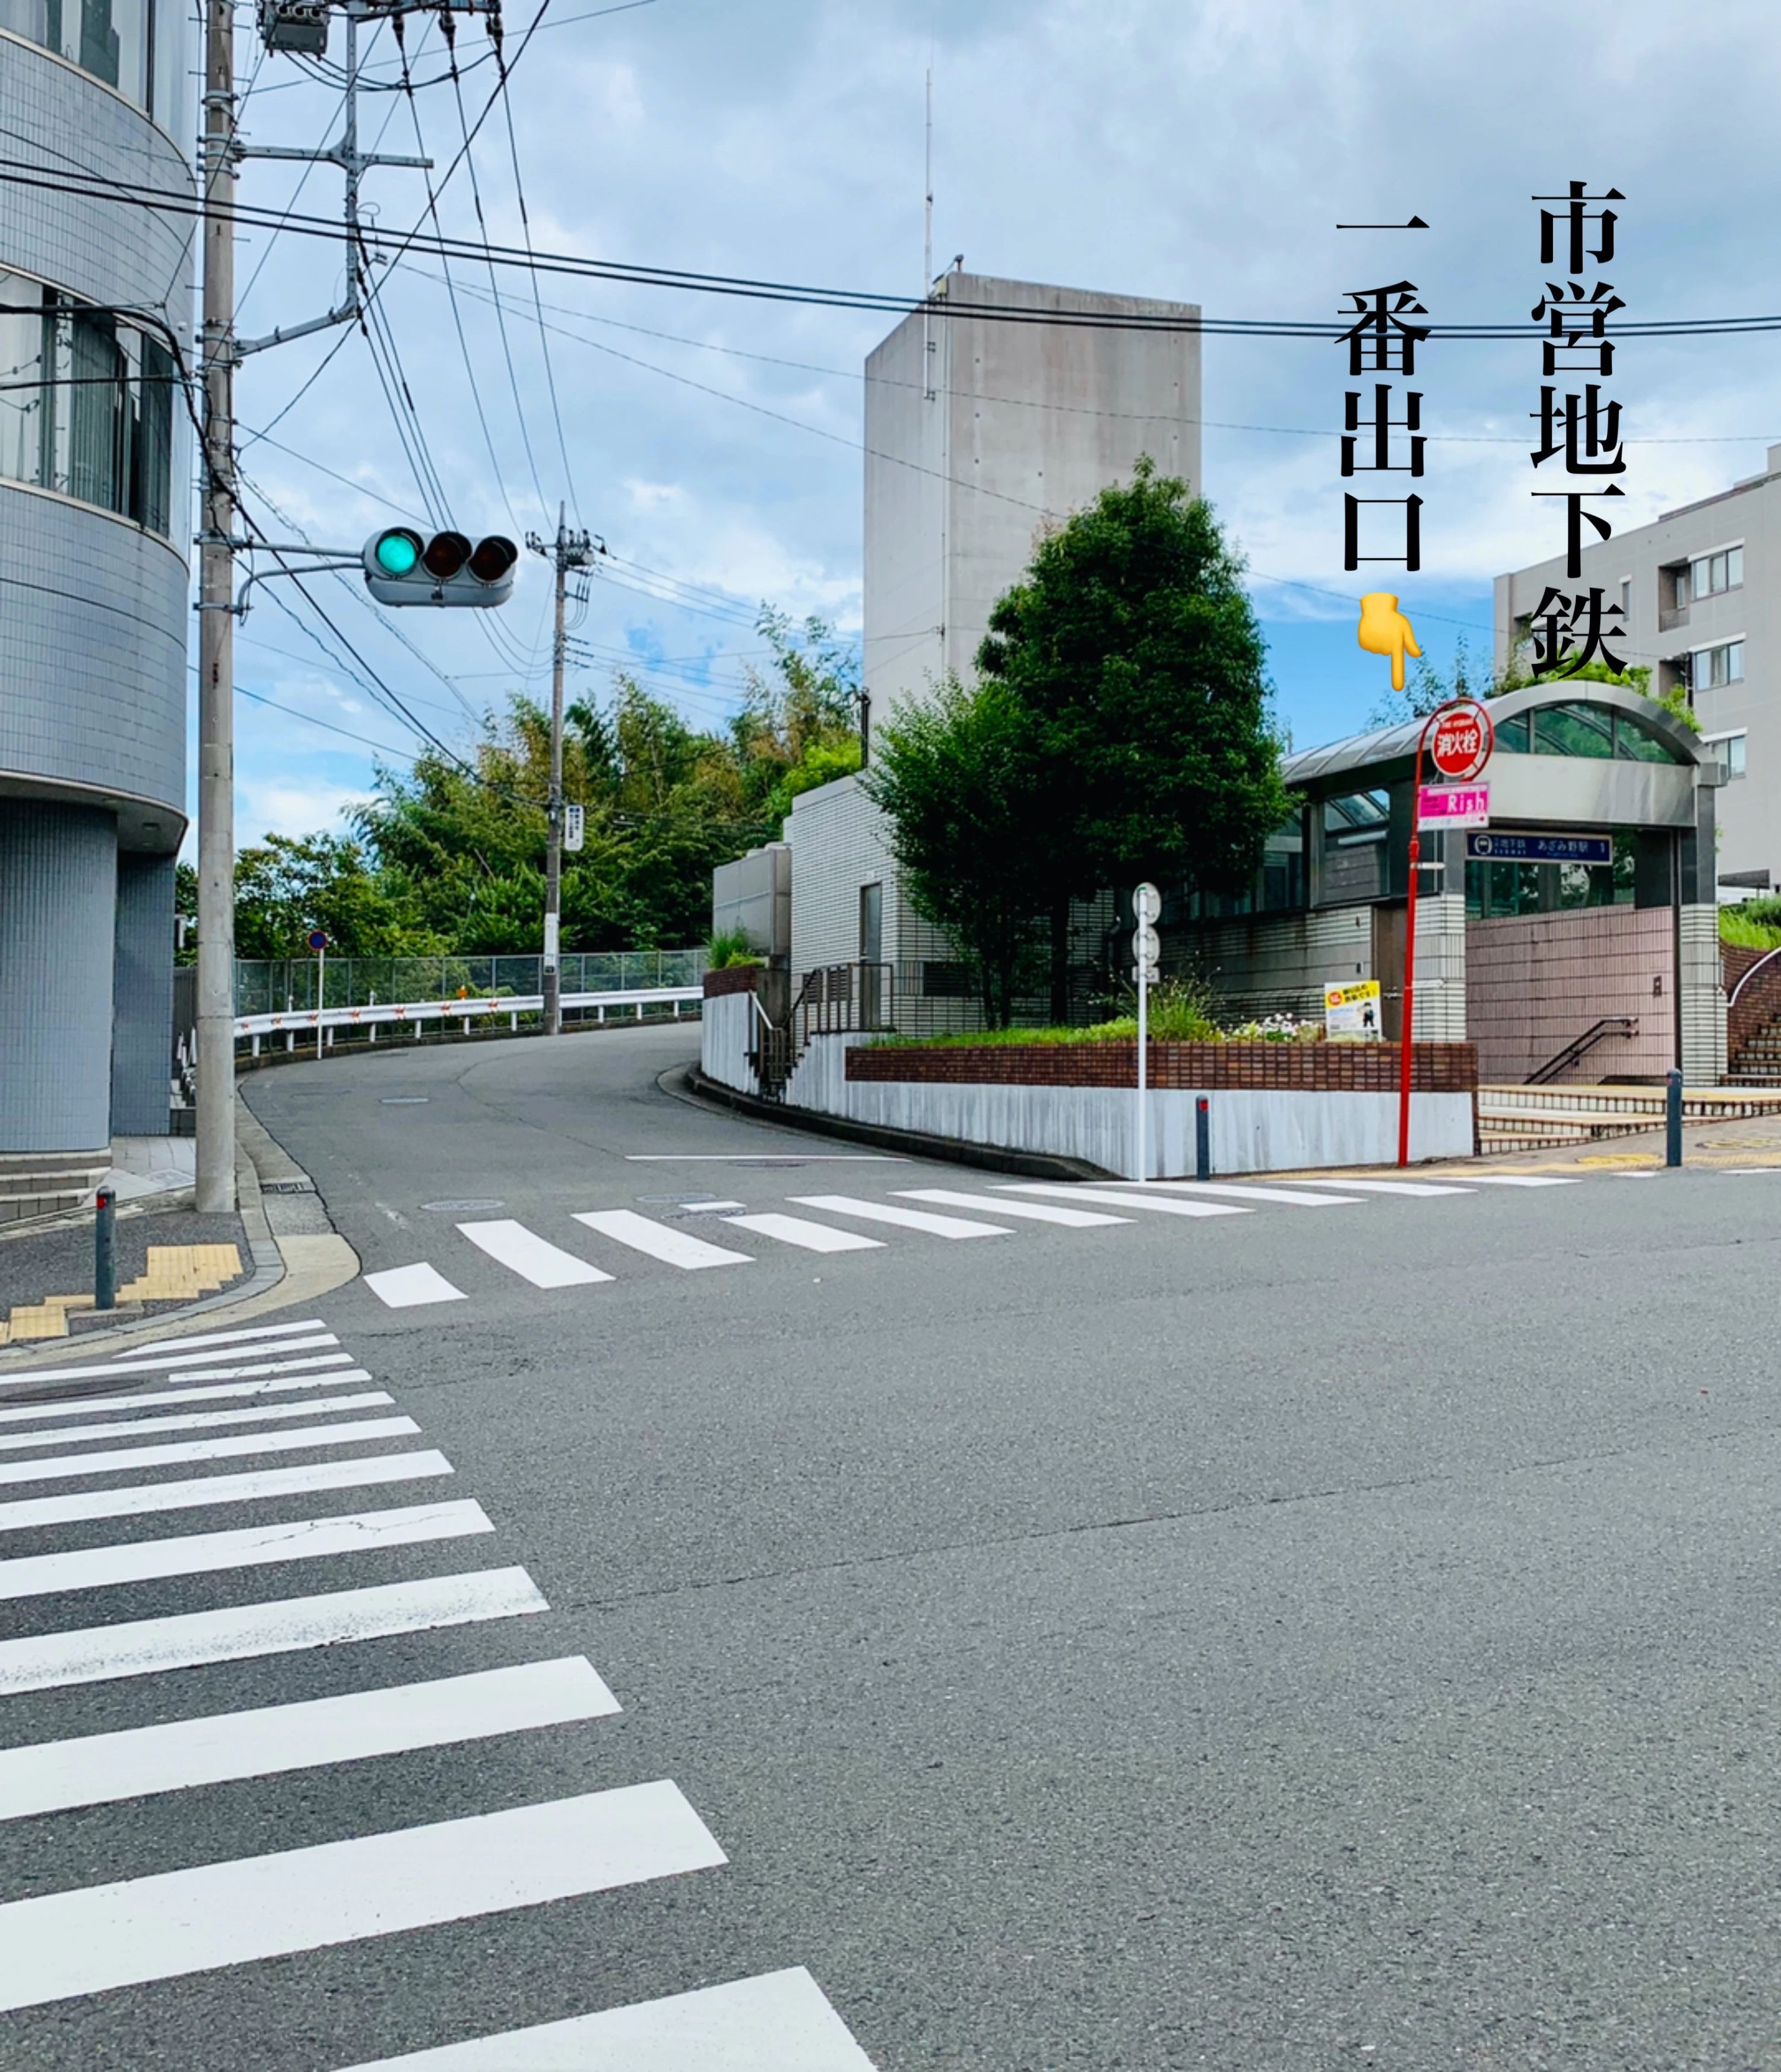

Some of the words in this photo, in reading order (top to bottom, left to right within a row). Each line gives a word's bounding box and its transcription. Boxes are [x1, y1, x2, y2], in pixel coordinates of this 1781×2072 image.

[1437, 728, 1478, 758] 消火栓
[1447, 791, 1485, 813] Rish
